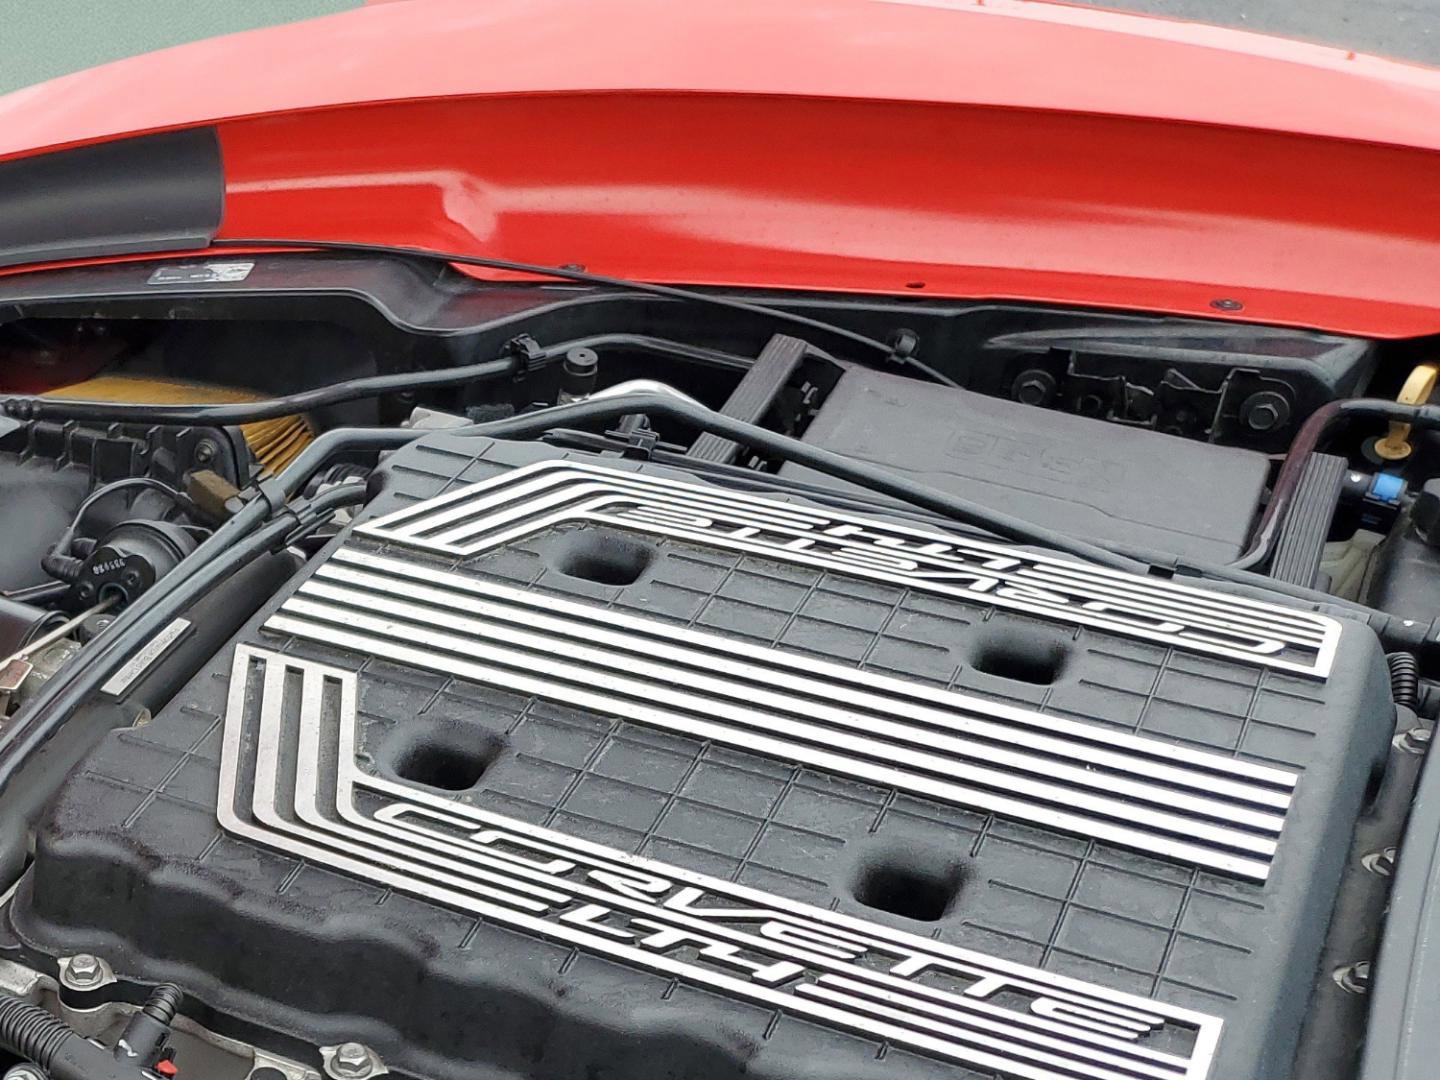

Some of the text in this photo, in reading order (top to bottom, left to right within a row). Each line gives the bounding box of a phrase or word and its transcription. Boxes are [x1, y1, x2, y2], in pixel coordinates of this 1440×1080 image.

[617, 506, 1287, 654] CORVETTE
[821, 523, 1018, 571] LT4
[373, 801, 1164, 1041] CORVETTE
[561, 907, 807, 985] LT4
